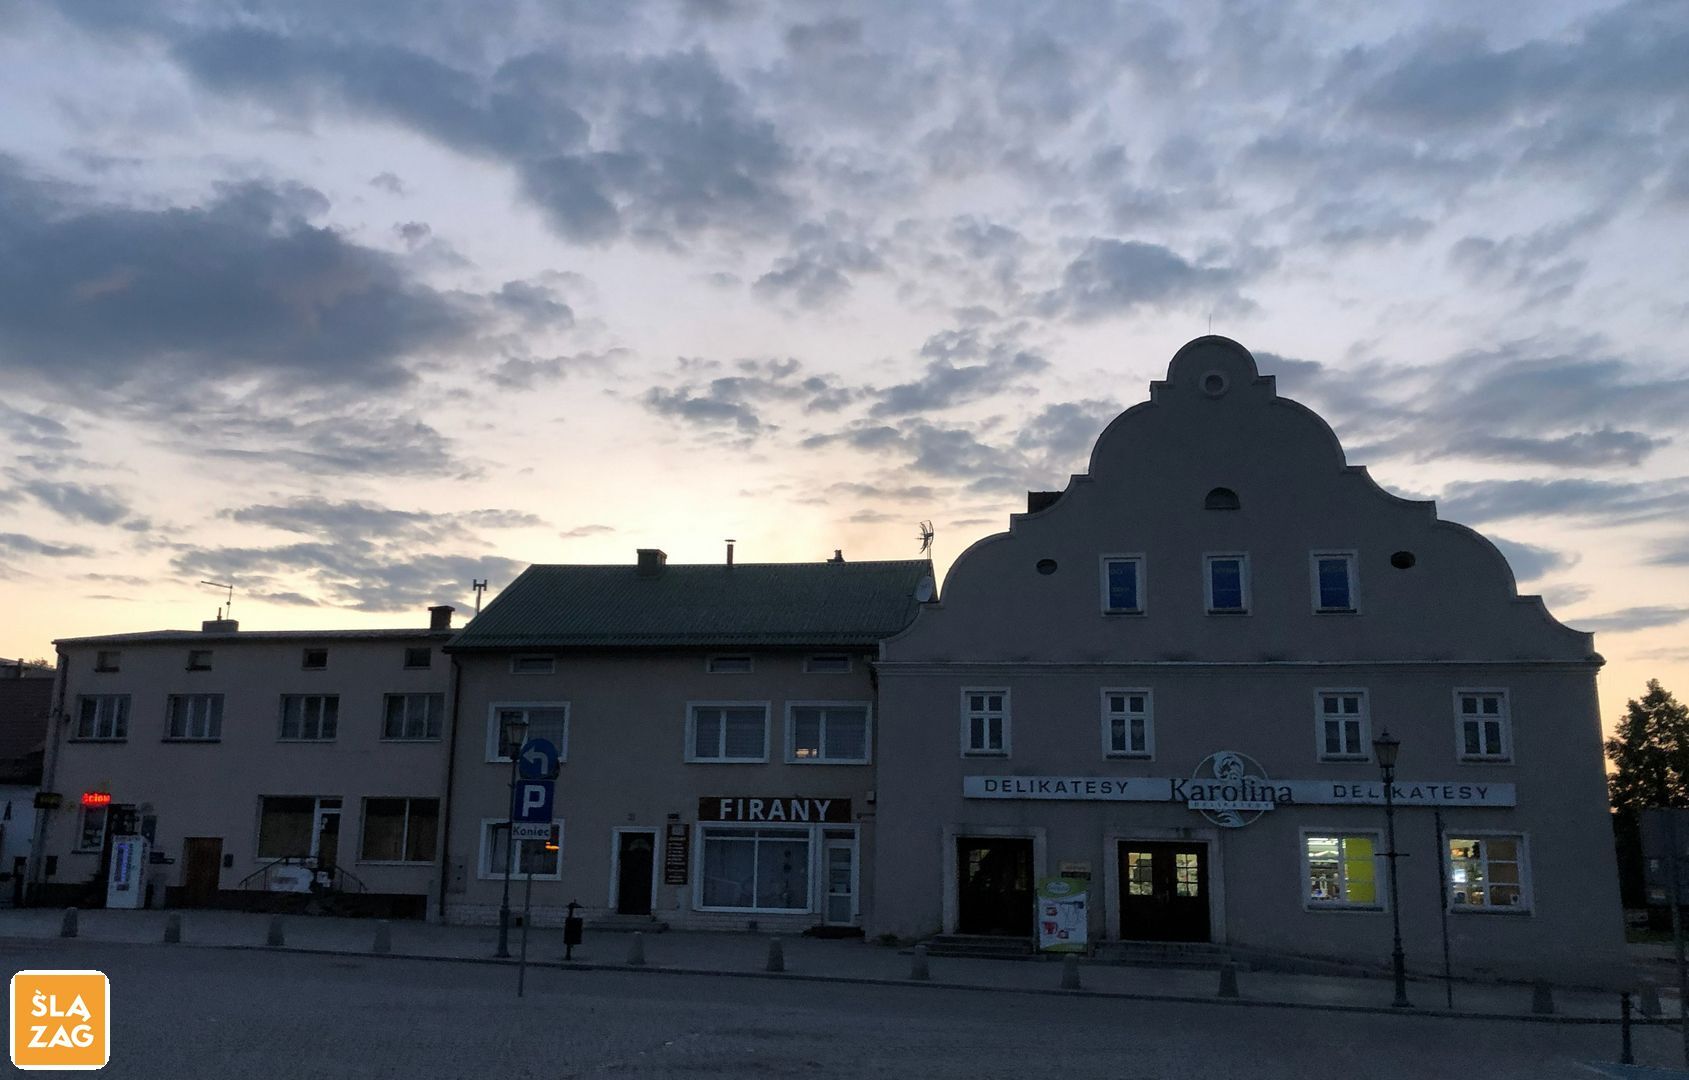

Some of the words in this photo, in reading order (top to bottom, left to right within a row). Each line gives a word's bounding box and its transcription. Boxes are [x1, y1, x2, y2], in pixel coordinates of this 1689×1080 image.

[985, 779, 1129, 794] DELIKATESY
[1170, 778, 1293, 802] Karolina
[521, 784, 546, 817] P
[719, 798, 832, 822] FIRANY
[512, 825, 550, 837] Koniec
